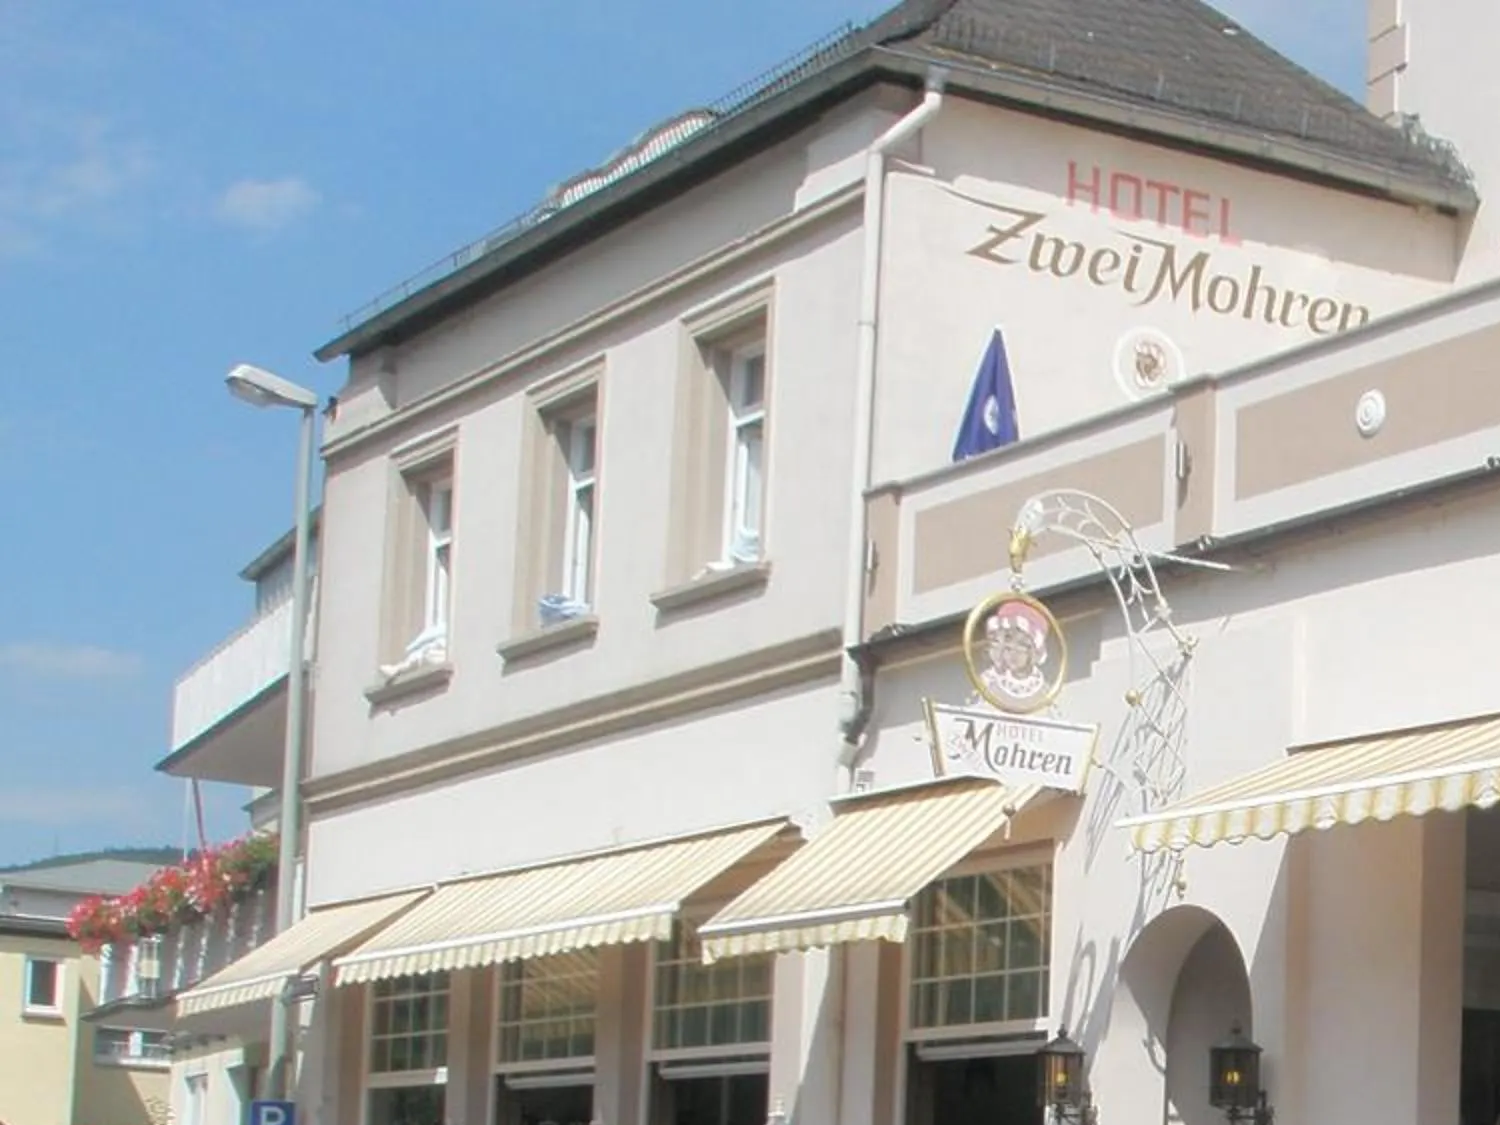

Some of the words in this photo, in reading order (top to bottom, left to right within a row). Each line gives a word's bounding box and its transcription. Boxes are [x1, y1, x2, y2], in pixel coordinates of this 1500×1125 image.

[1066, 159, 1243, 247] HOTEL
[938, 182, 1143, 293] Zwei
[1111, 229, 1371, 334] Mohren
[947, 717, 1073, 776] Mohren
[996, 721, 1044, 743] HOTEL
